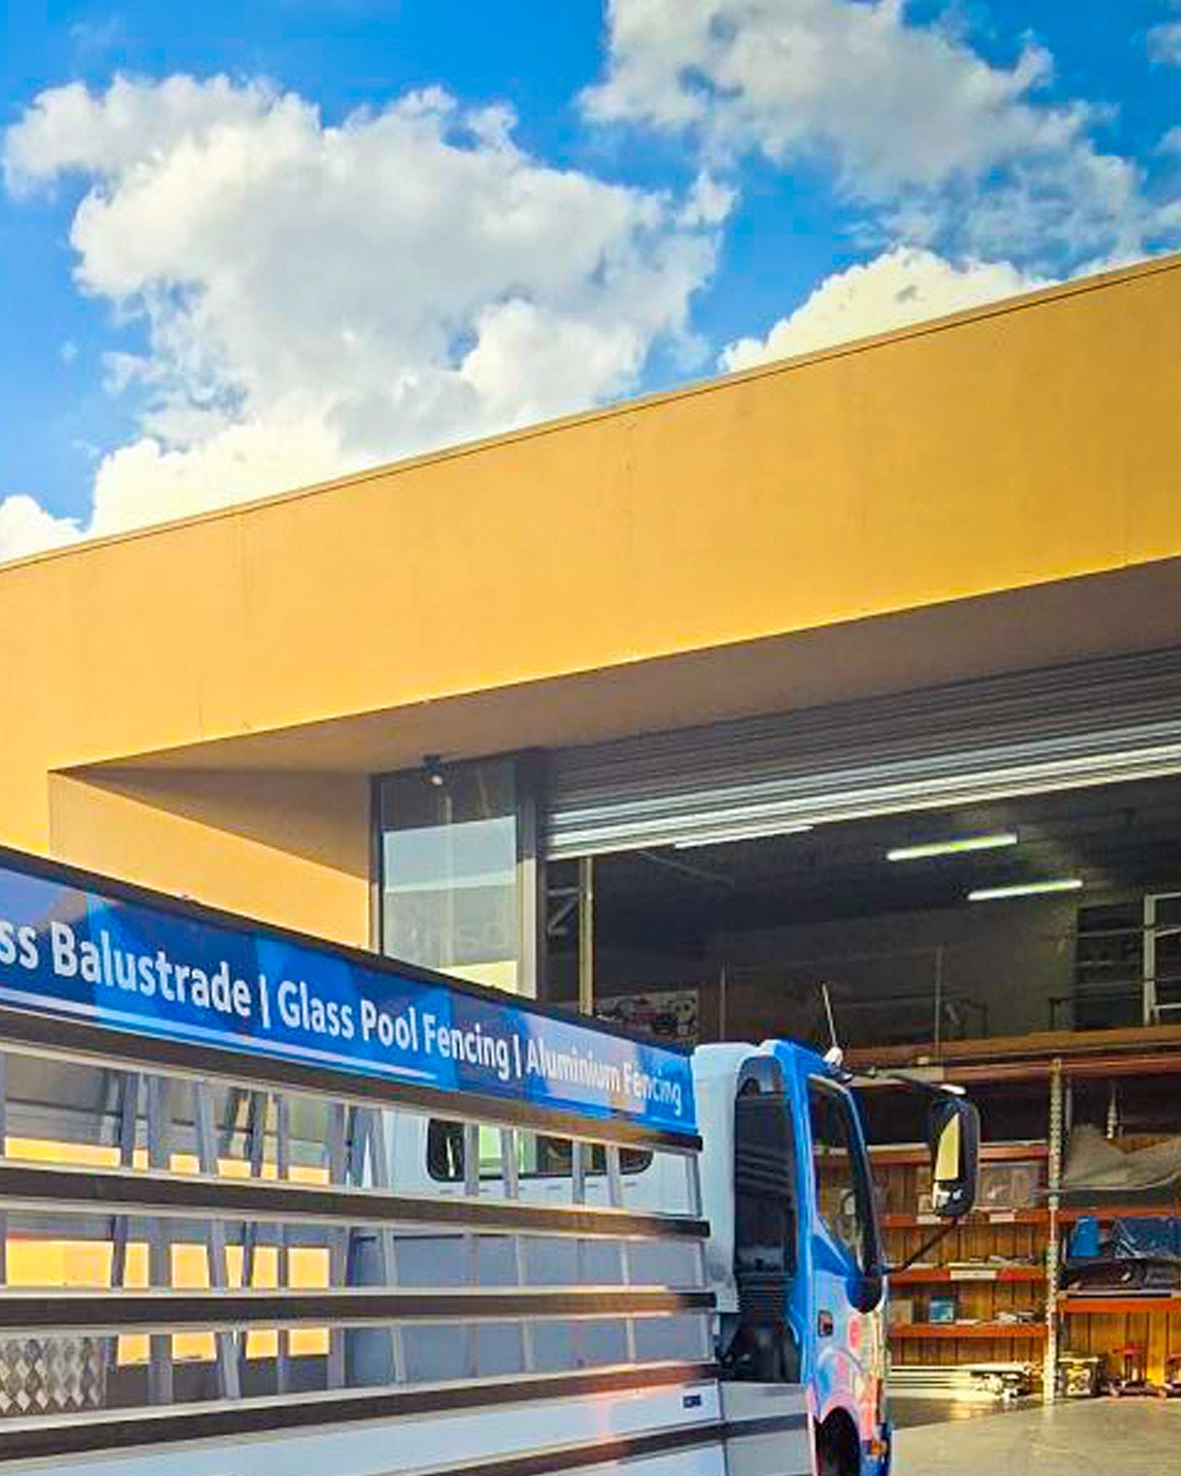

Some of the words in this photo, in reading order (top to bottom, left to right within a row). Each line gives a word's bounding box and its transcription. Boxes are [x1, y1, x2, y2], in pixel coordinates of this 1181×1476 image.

[51, 921, 251, 1017] Balustrade
[277, 980, 355, 1040] Glass
[361, 999, 418, 1052] Pool
[422, 1013, 509, 1082] Fencing
[526, 1038, 620, 1093] Aluminium
[624, 1061, 682, 1117] Fencing
